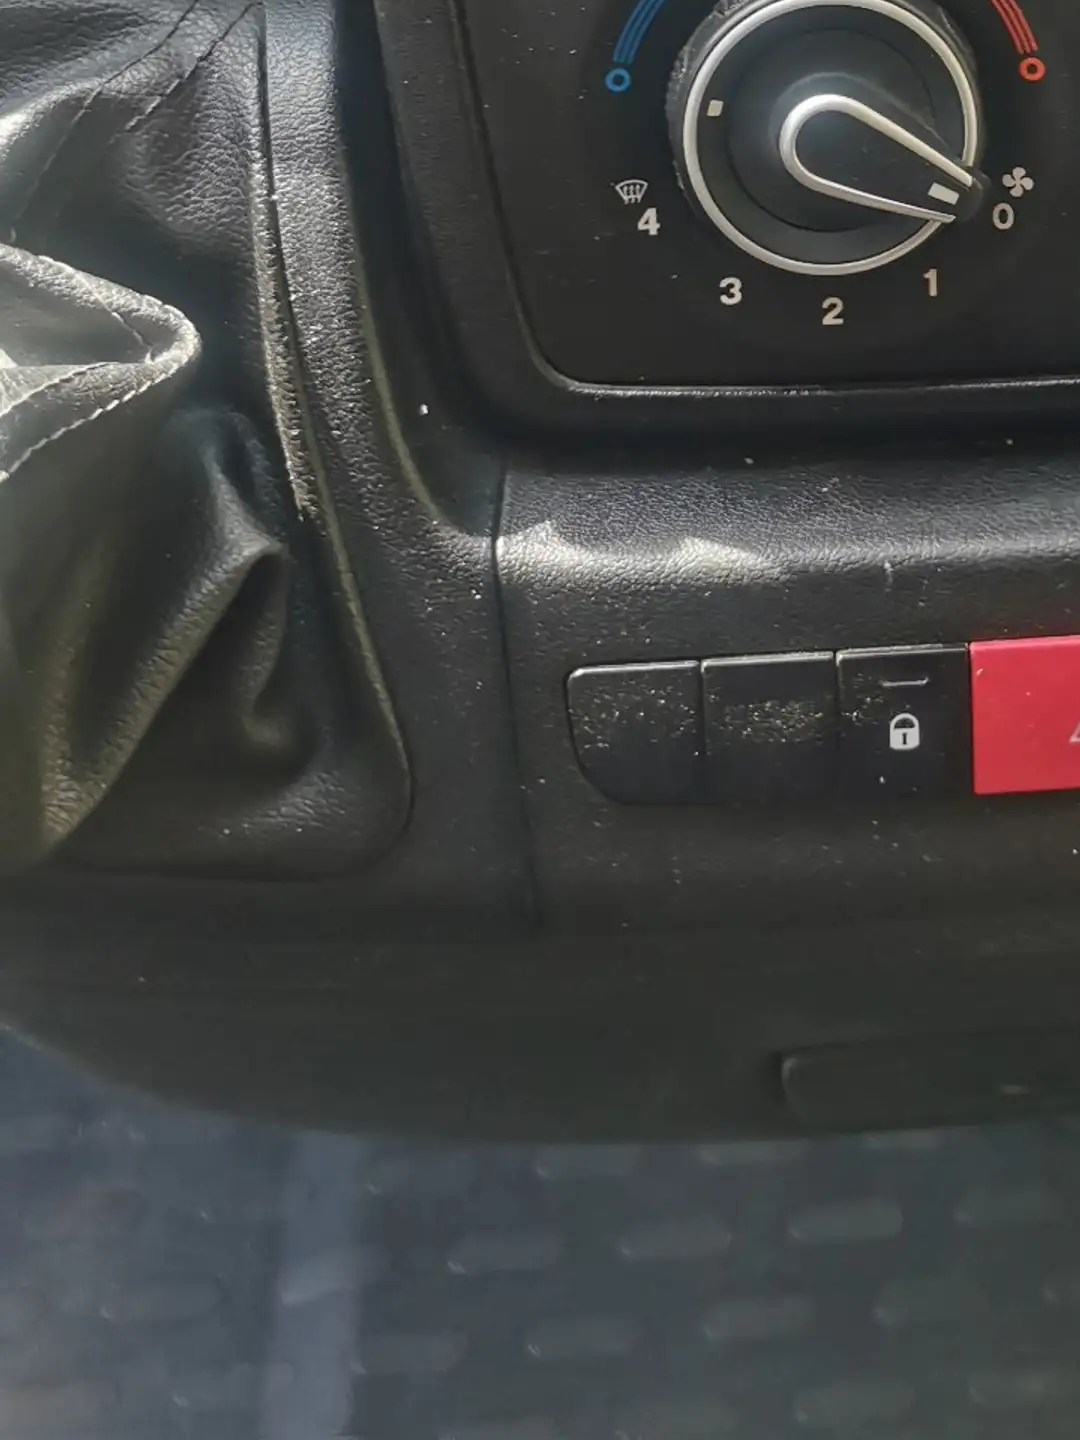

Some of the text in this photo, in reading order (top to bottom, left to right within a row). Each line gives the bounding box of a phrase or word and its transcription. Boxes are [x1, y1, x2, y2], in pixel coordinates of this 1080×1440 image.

[637, 207, 660, 236] 4
[992, 202, 1014, 230] 0
[719, 277, 742, 305] 3
[922, 268, 938, 297] 1
[821, 297, 844, 326] 2
